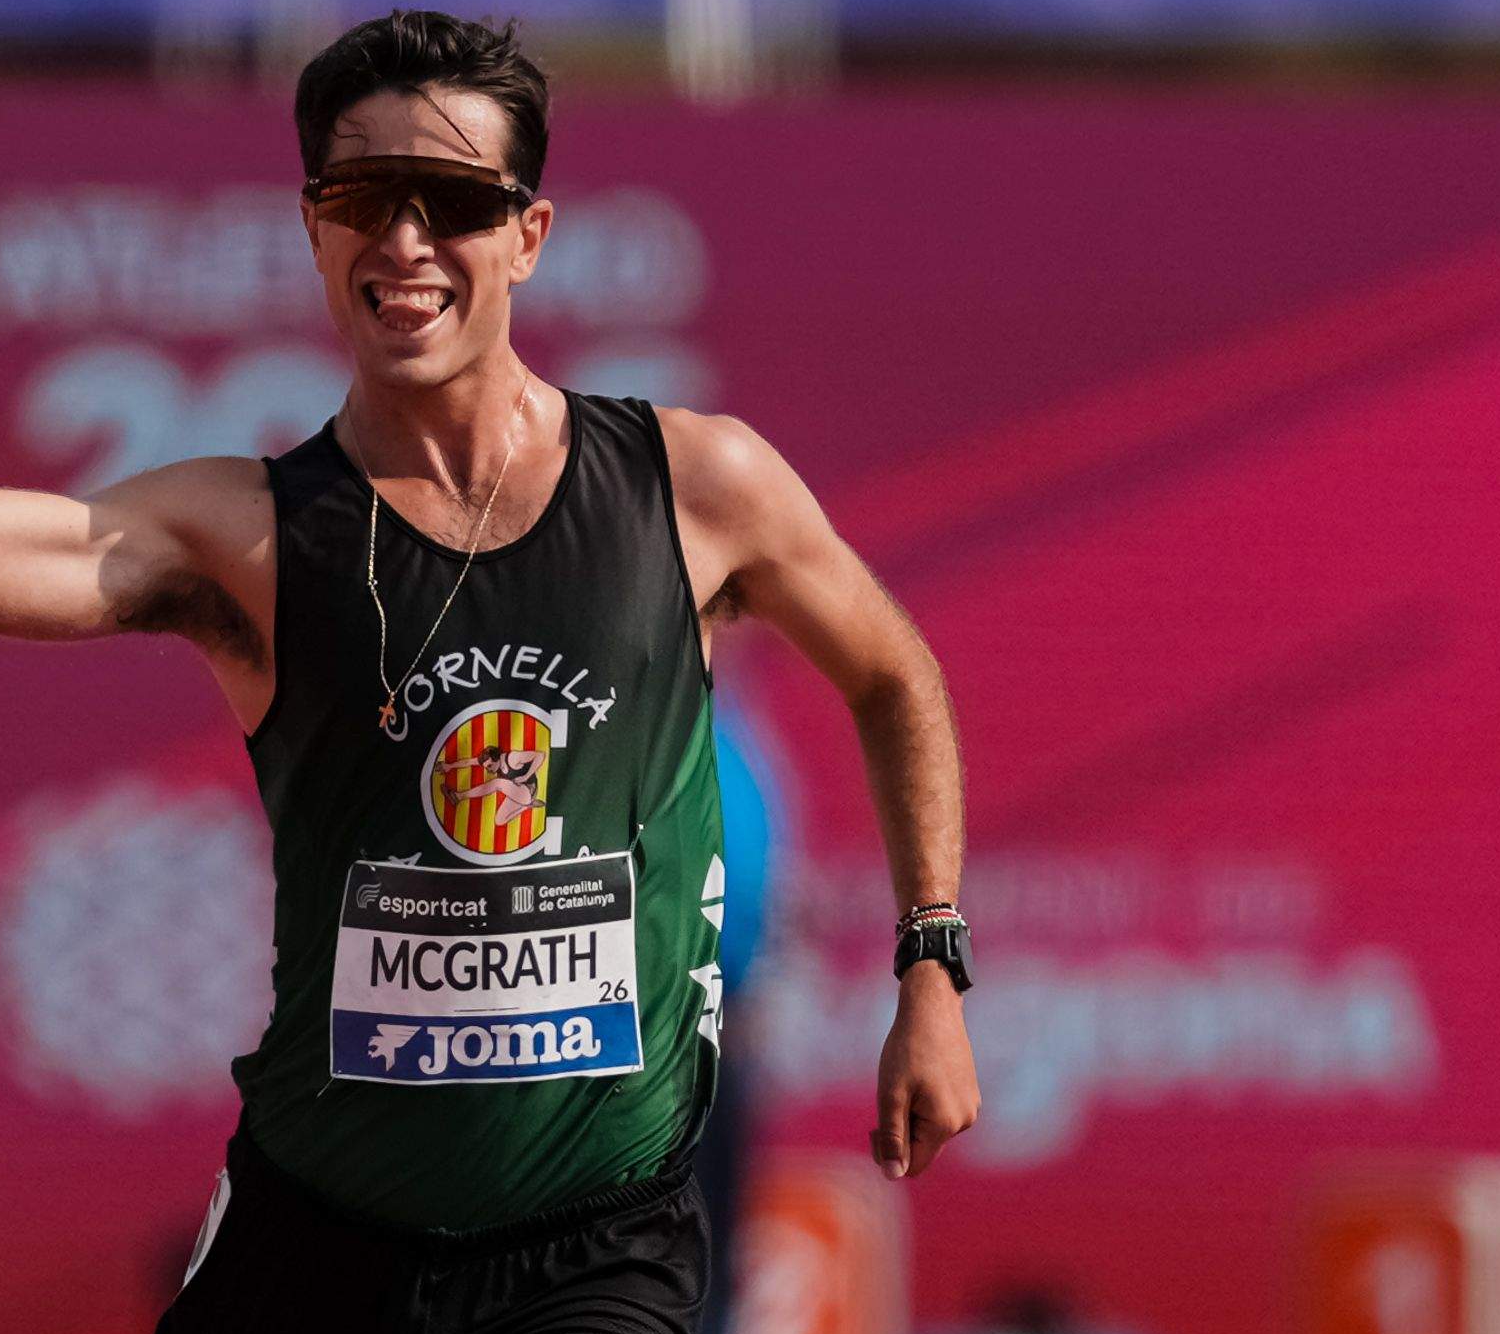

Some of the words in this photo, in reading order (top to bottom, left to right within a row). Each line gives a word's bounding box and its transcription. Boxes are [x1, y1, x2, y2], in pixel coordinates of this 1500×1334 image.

[539, 879, 603, 898] Generalitat
[378, 897, 487, 919] esportcat
[539, 900, 555, 912] de
[556, 893, 615, 910] Catalunya
[370, 931, 597, 991] MCGRATH
[599, 979, 629, 1002] 26
